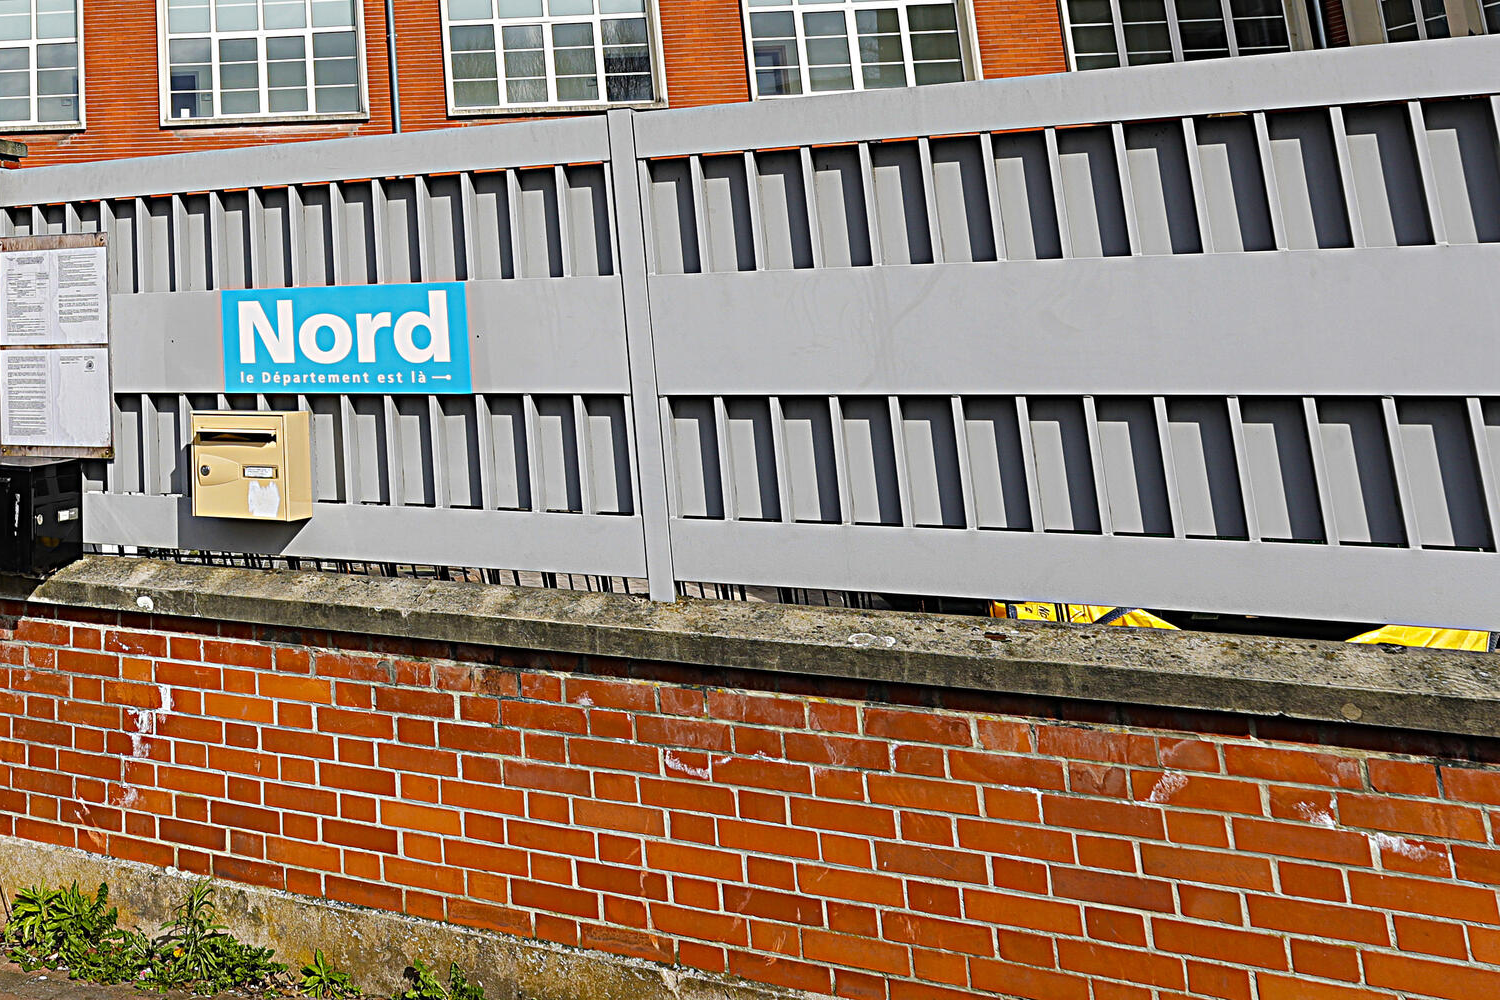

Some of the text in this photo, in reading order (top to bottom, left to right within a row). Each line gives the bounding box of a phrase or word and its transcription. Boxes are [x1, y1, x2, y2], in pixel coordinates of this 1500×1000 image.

[237, 290, 451, 364] Nord
[240, 371, 426, 386] le Département est là
